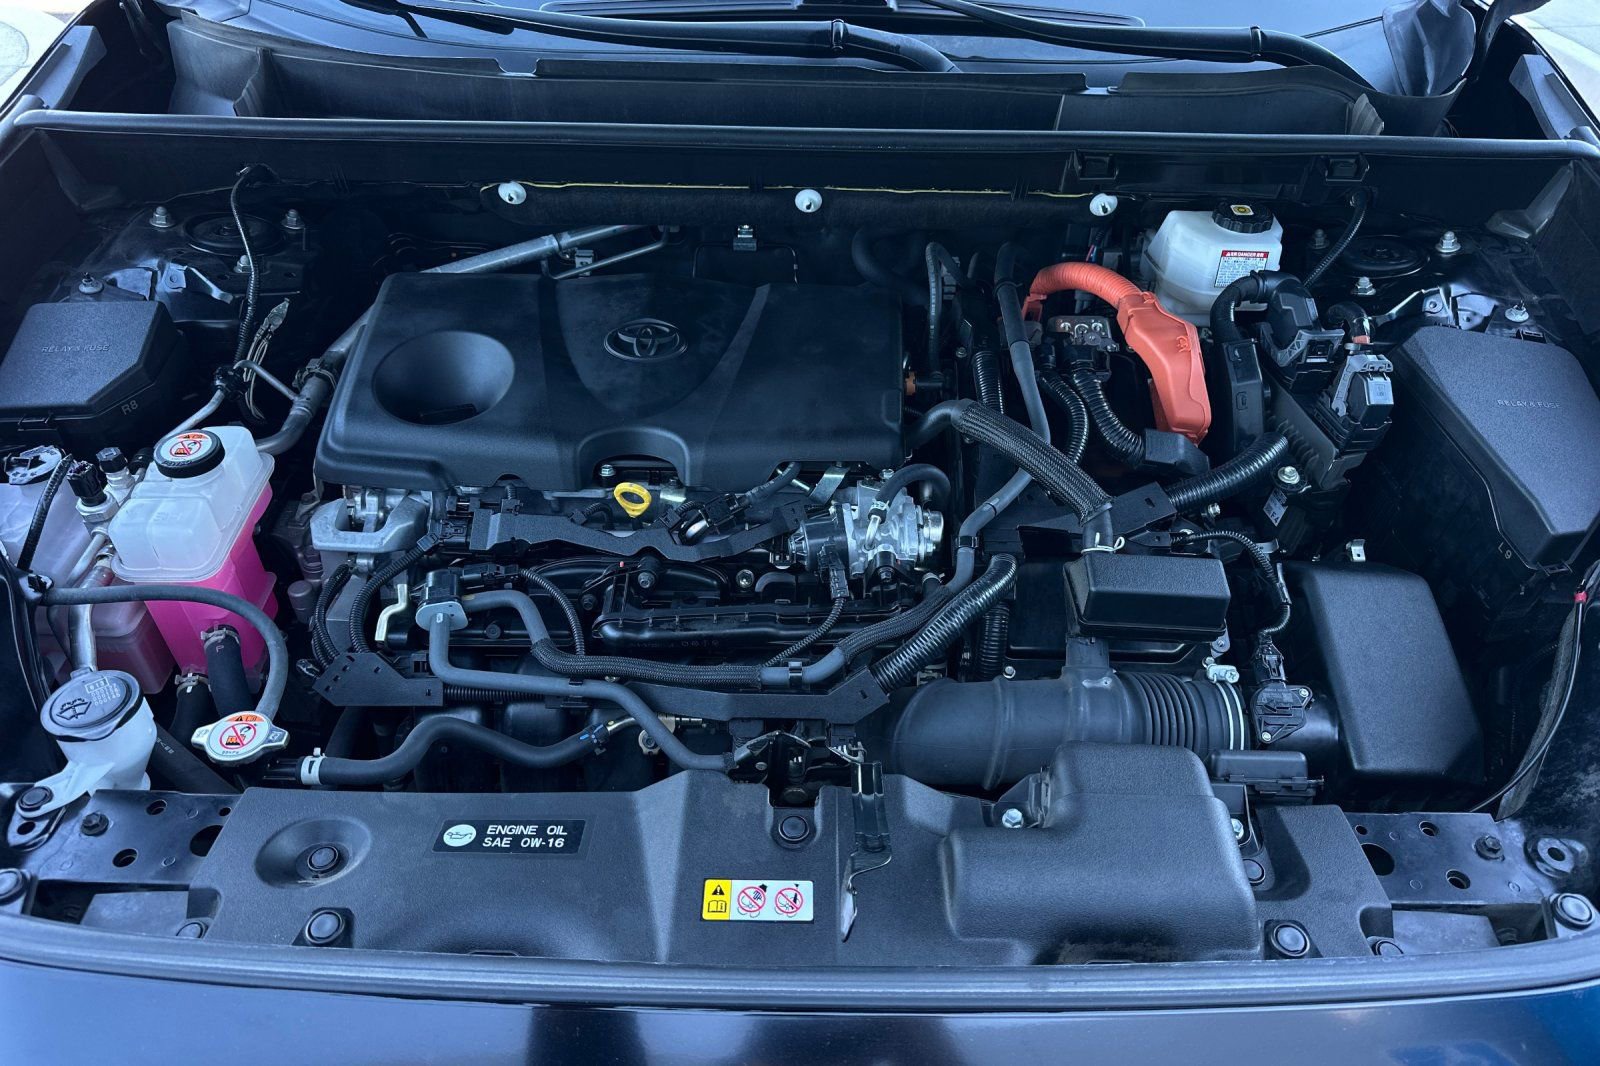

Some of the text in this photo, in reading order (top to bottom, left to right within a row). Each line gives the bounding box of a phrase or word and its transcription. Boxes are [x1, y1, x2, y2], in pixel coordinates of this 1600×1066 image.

[41, 345, 73, 353] RELAY
[81, 344, 111, 352] FUSE
[121, 400, 139, 415] R8
[1497, 399, 1527, 407] RELAY
[1537, 401, 1561, 409] FUSE
[486, 825, 568, 836] ENGINE OIL
[482, 837, 565, 848] SAE 0W-16
